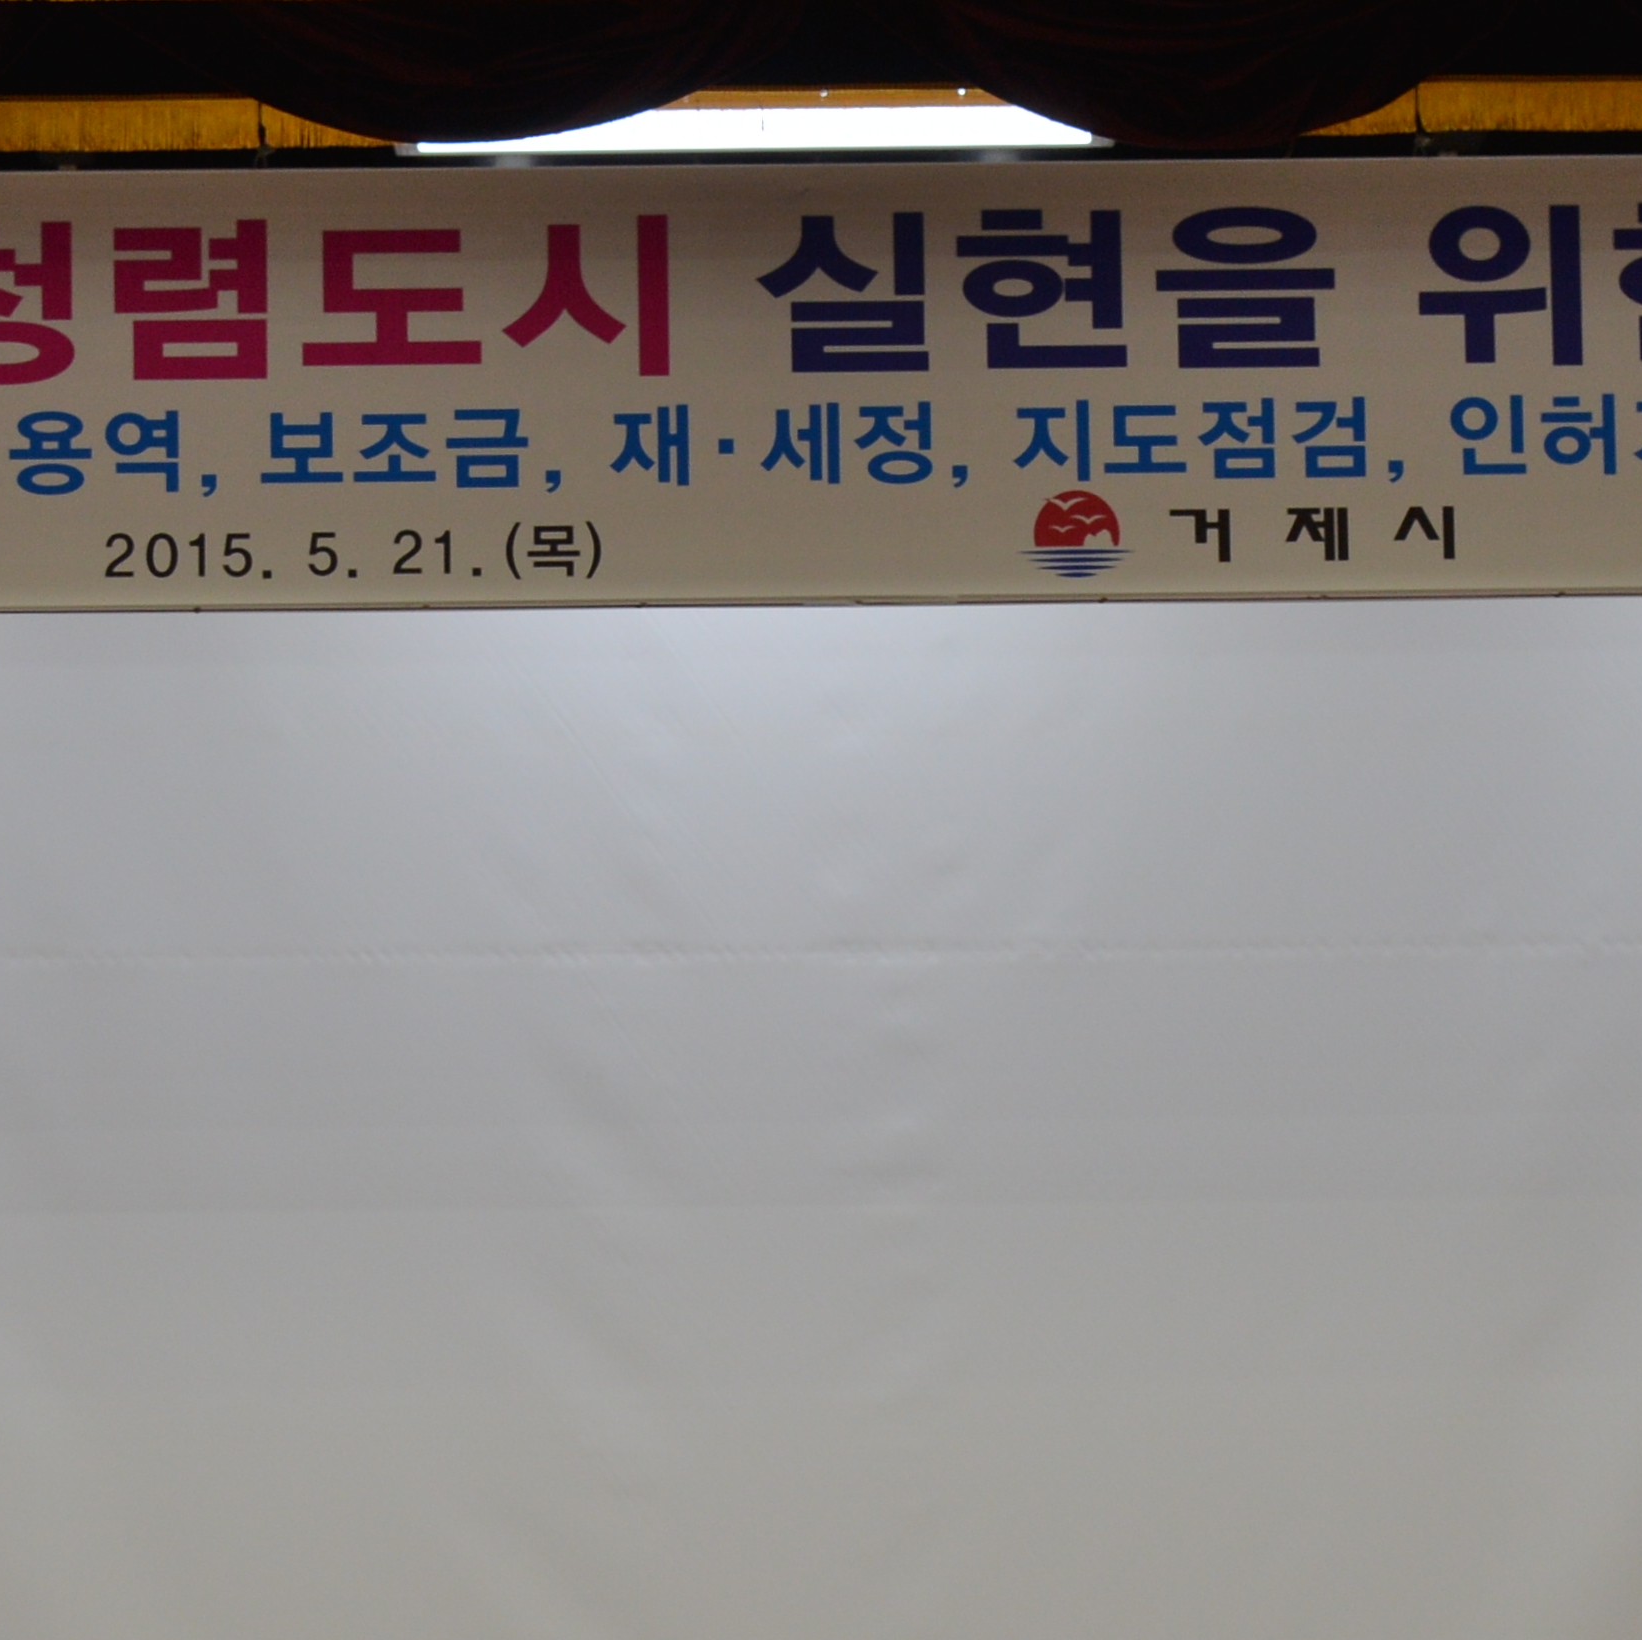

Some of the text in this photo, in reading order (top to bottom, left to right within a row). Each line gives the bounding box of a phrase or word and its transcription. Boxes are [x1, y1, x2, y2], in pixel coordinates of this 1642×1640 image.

[756, 205, 1336, 373] 실현을
[260, 408, 561, 493] 보조금,
[1013, 396, 1404, 483] 지도점검,
[104, 532, 273, 580] 2015.
